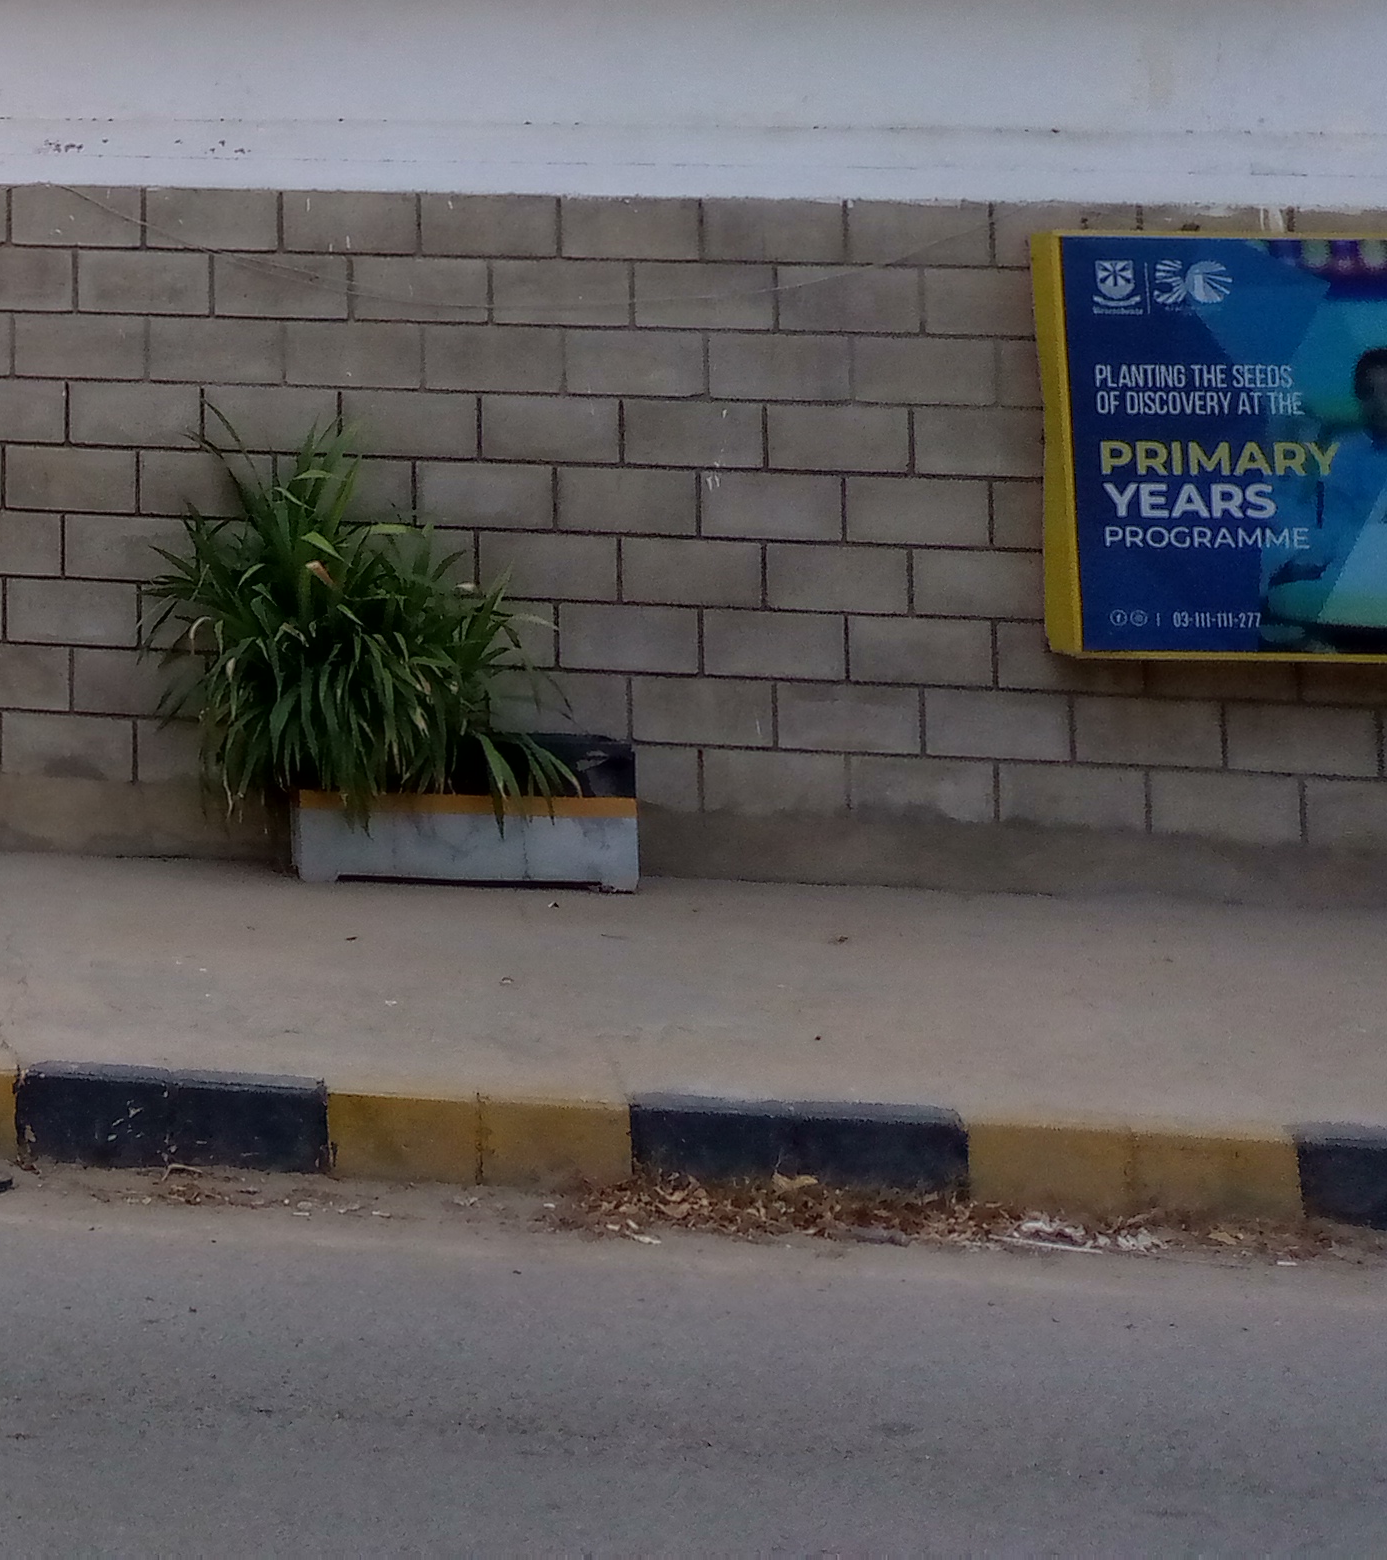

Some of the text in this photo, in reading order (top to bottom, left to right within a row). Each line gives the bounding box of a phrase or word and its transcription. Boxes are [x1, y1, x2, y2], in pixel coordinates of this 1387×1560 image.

[1095, 363, 1293, 388] PLANTING THE SEEDS
[1096, 391, 1305, 416] OF DISCOVERY AT THE
[1100, 440, 1340, 476] PRIMARY
[1103, 482, 1278, 519] YEARS
[1104, 526, 1310, 550] PROGRAMME
[1172, 611, 1262, 628] 03-111-111-277
